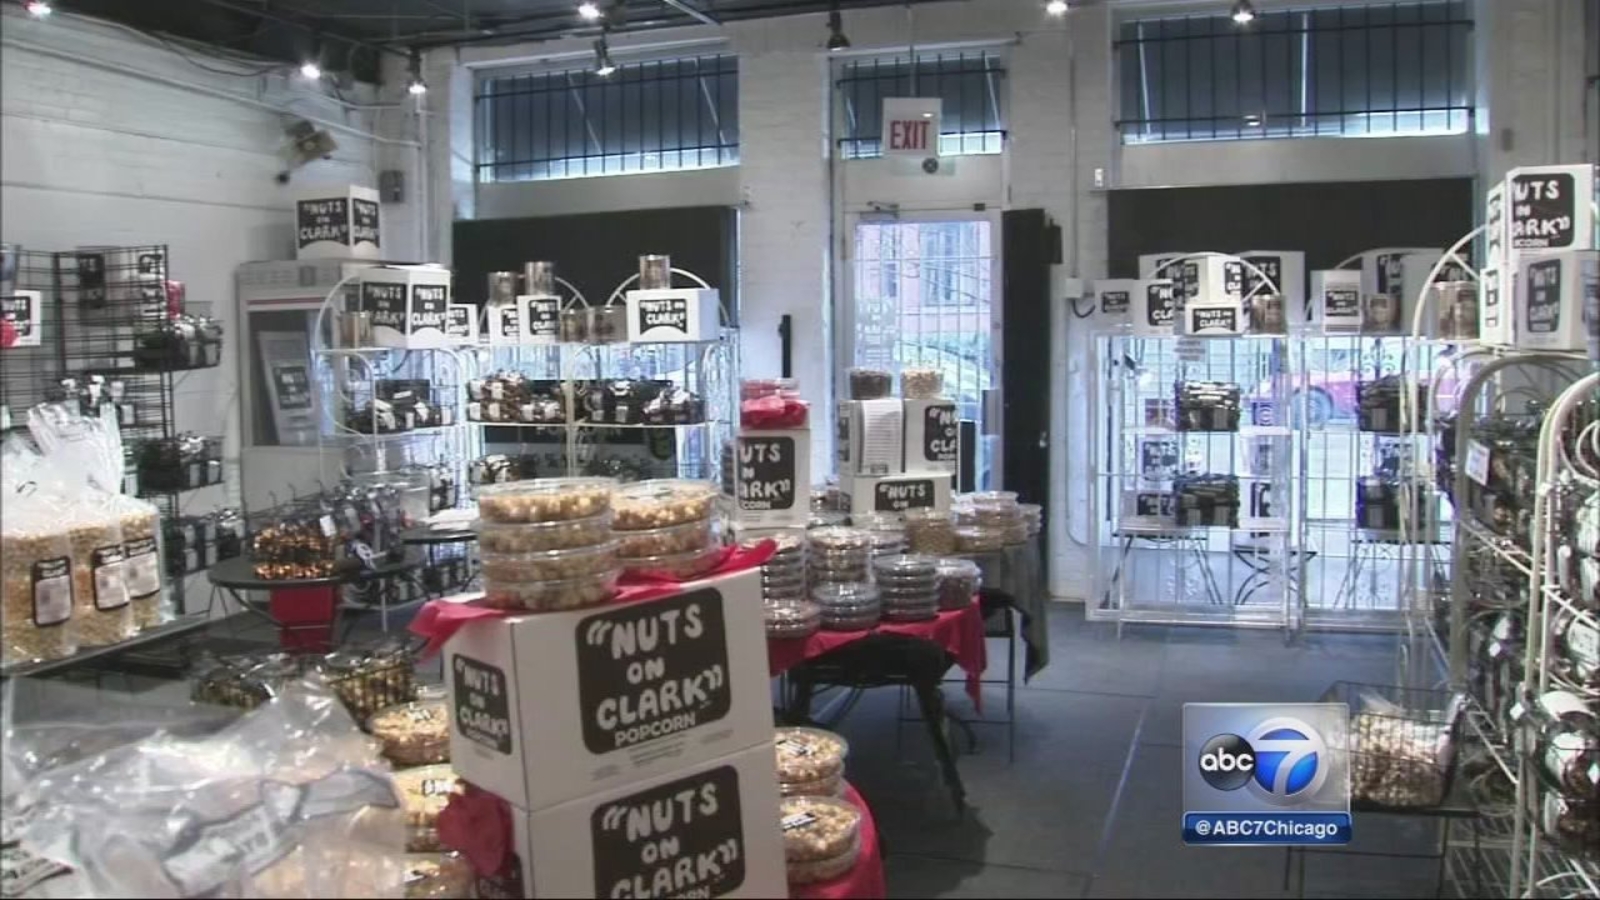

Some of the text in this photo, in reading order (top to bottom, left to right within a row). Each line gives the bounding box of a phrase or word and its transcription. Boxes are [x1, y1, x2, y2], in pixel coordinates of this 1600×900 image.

[890, 121, 931, 150] EXIT
[586, 603, 703, 660] "NUTS
[626, 656, 665, 684] ON
[596, 664, 723, 731] CLARK"
[614, 712, 696, 747] POPCORN
[603, 782, 719, 843] "NUTS
[641, 836, 680, 864] ON
